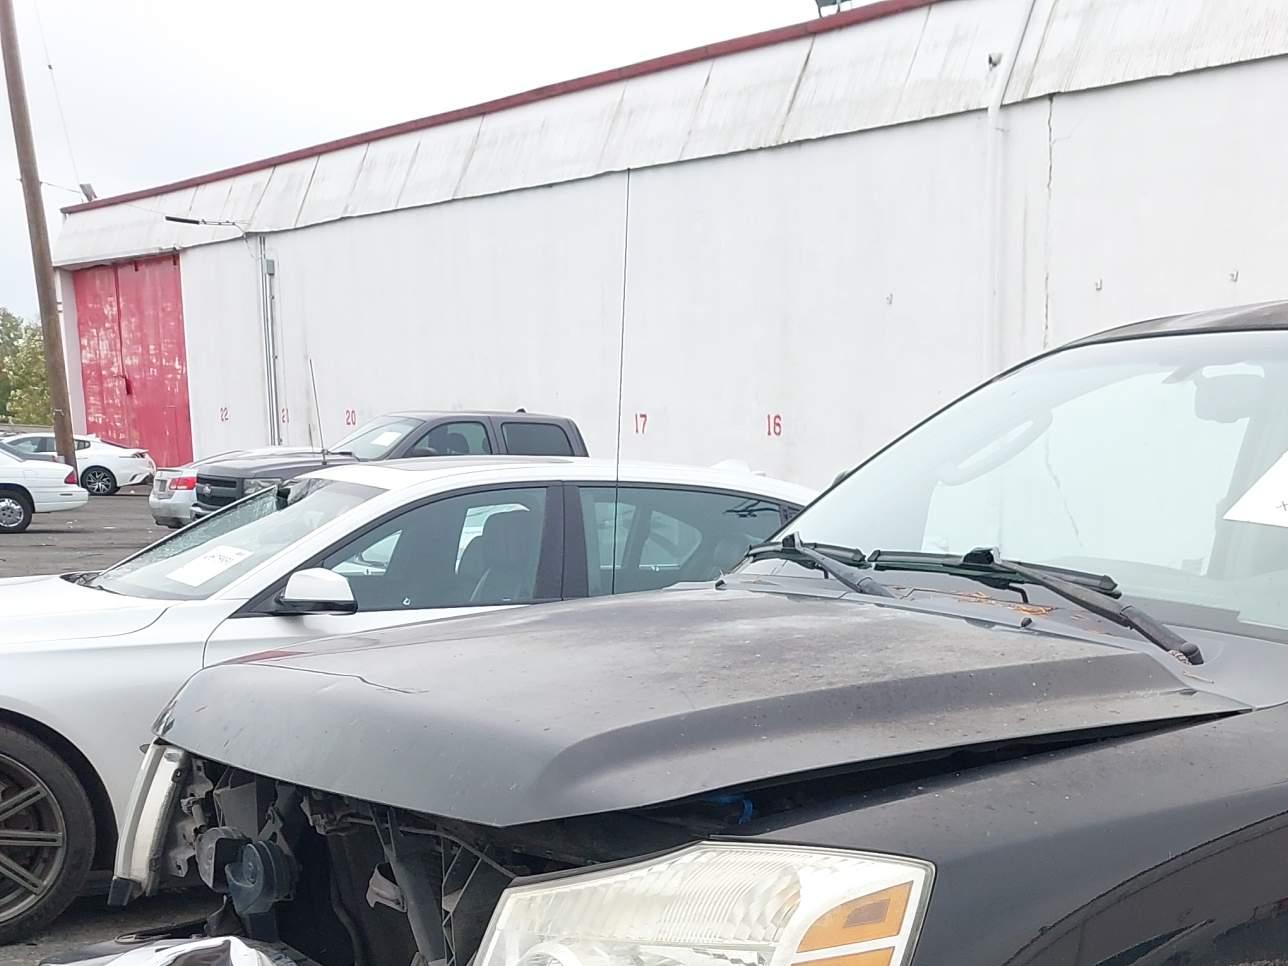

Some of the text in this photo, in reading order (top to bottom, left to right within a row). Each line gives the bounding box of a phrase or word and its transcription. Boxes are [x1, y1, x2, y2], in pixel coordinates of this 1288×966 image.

[219, 407, 229, 422] 22
[345, 409, 357, 426] 20
[634, 413, 648, 434] 17
[767, 413, 782, 436] 16
